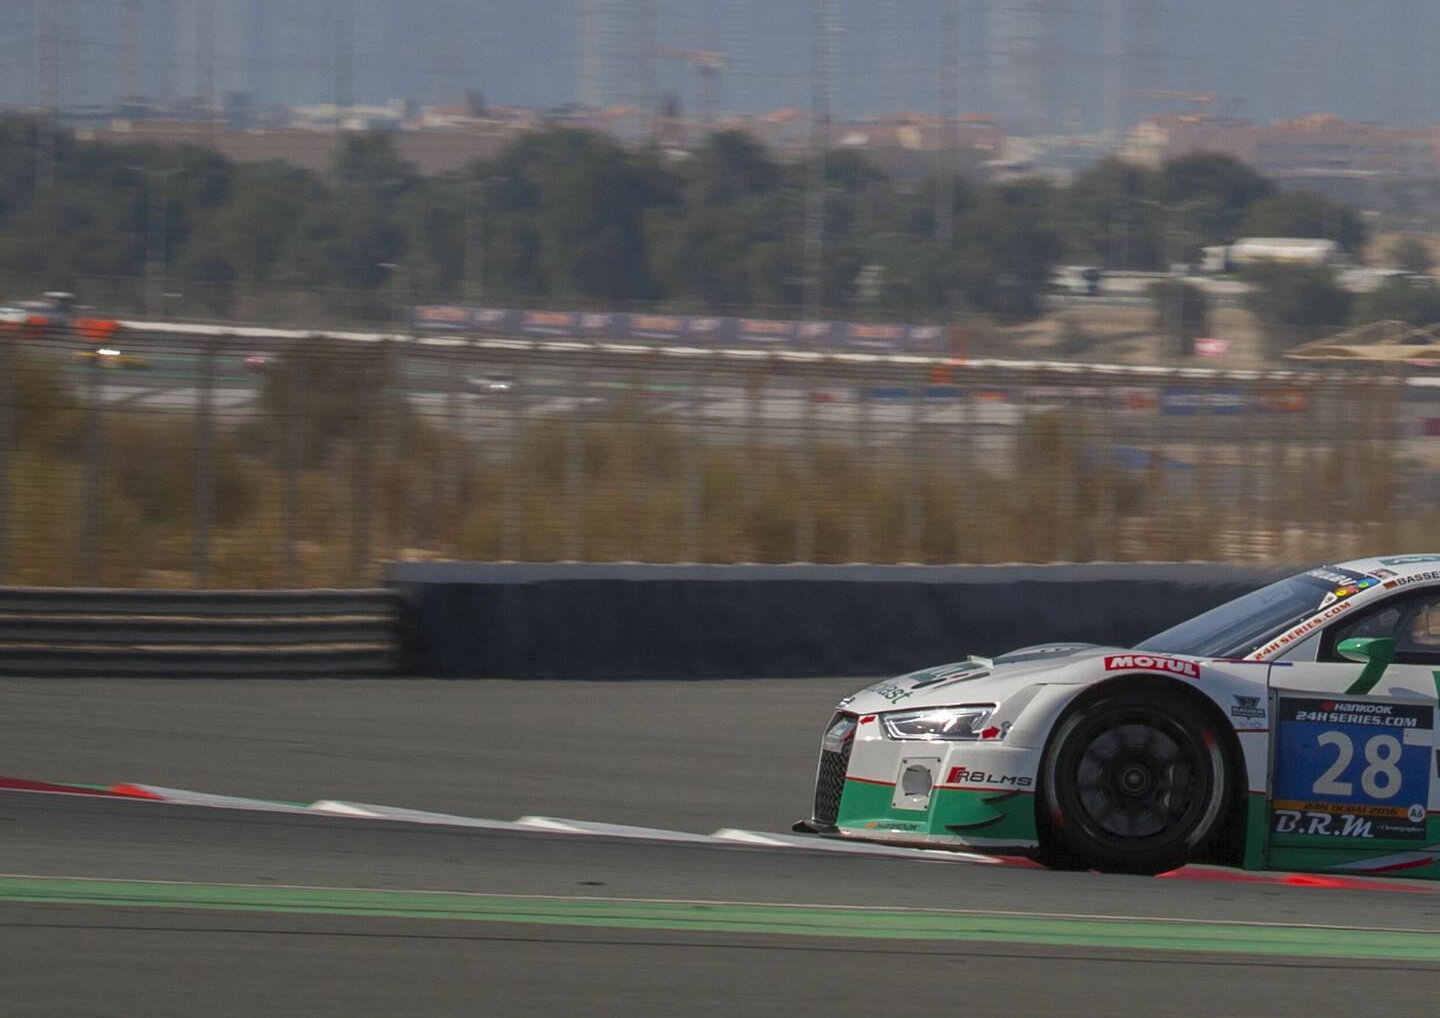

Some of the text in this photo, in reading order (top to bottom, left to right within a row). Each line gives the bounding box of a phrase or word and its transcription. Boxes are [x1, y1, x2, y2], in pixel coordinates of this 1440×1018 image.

[1254, 601, 1352, 662] 24H SERIES.COM
[1110, 656, 1197, 676] MOTUL
[1312, 731, 1403, 799] 28
[1410, 808, 1424, 818] A6
